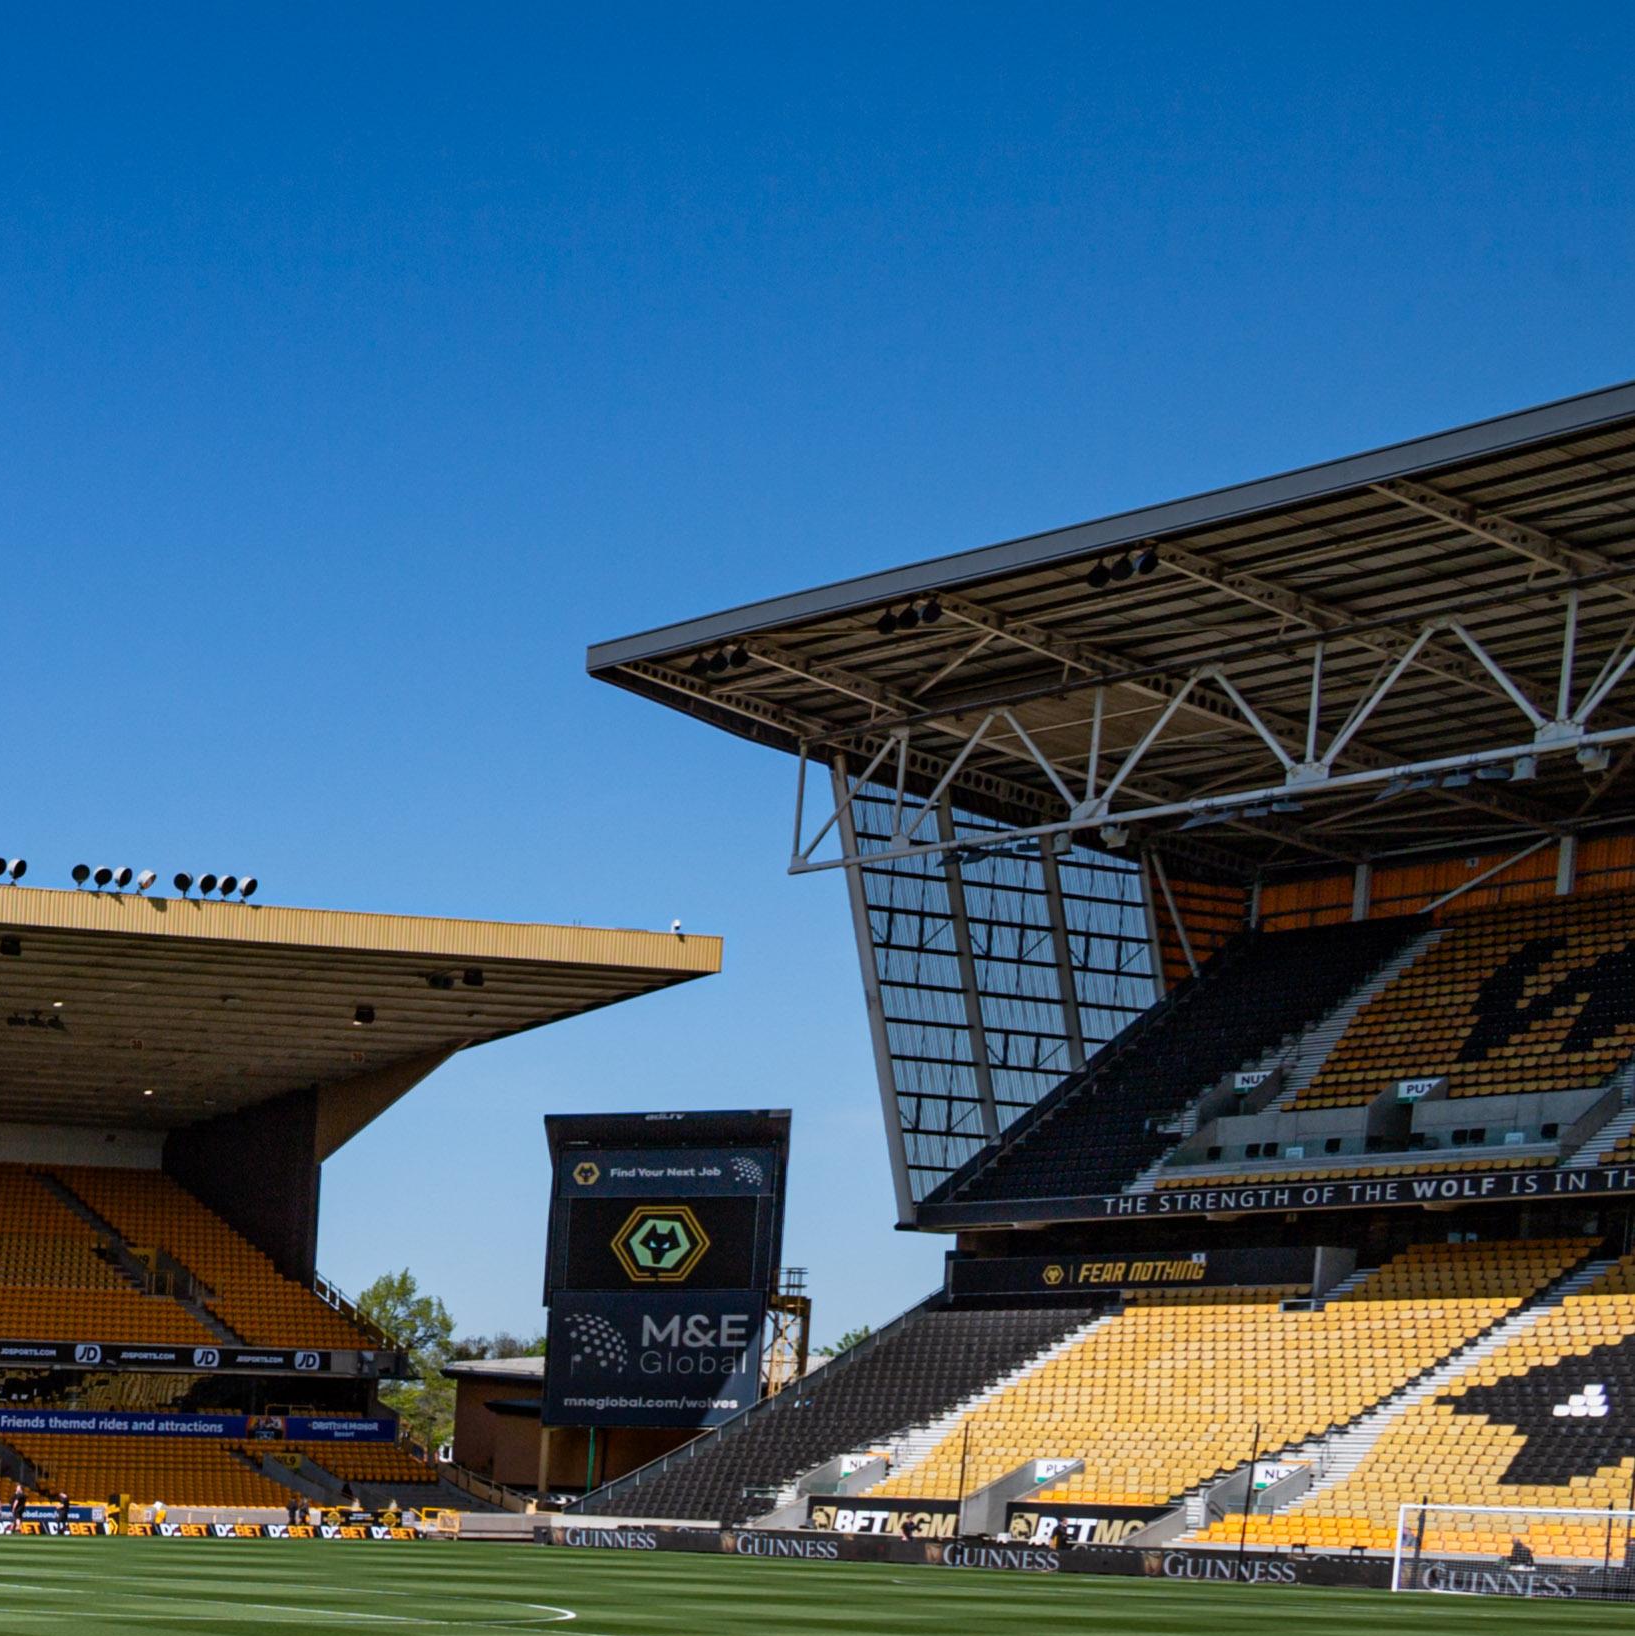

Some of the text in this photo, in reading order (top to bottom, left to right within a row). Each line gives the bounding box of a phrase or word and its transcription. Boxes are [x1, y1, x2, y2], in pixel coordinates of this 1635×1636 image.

[610, 1166, 722, 1178] Find Your Next Job
[1104, 1172, 1589, 1214] THE STRENGTH OF THE WOLF IS IN
[1078, 1260, 1208, 1283] FEAR NOTHING
[641, 1314, 749, 1348] M&E
[78, 1346, 97, 1361] JD
[197, 1350, 216, 1365] JD
[298, 1353, 317, 1368] JD
[639, 1350, 747, 1374] Global
[563, 1396, 739, 1410] mneglobal.com/wolves
[0, 1416, 46, 1430] Friends
[48, 1416, 96, 1431] themed
[99, 1418, 129, 1431] rides
[131, 1419, 155, 1432] and
[157, 1420, 224, 1433] attractions
[566, 1527, 657, 1550] GUINNESS
[737, 1532, 838, 1559] GUINNESS
[942, 1542, 1060, 1571] GUINNESS
[1162, 1554, 1297, 1583] GUINNESS
[1422, 1566, 1577, 1597] GUINNESS
